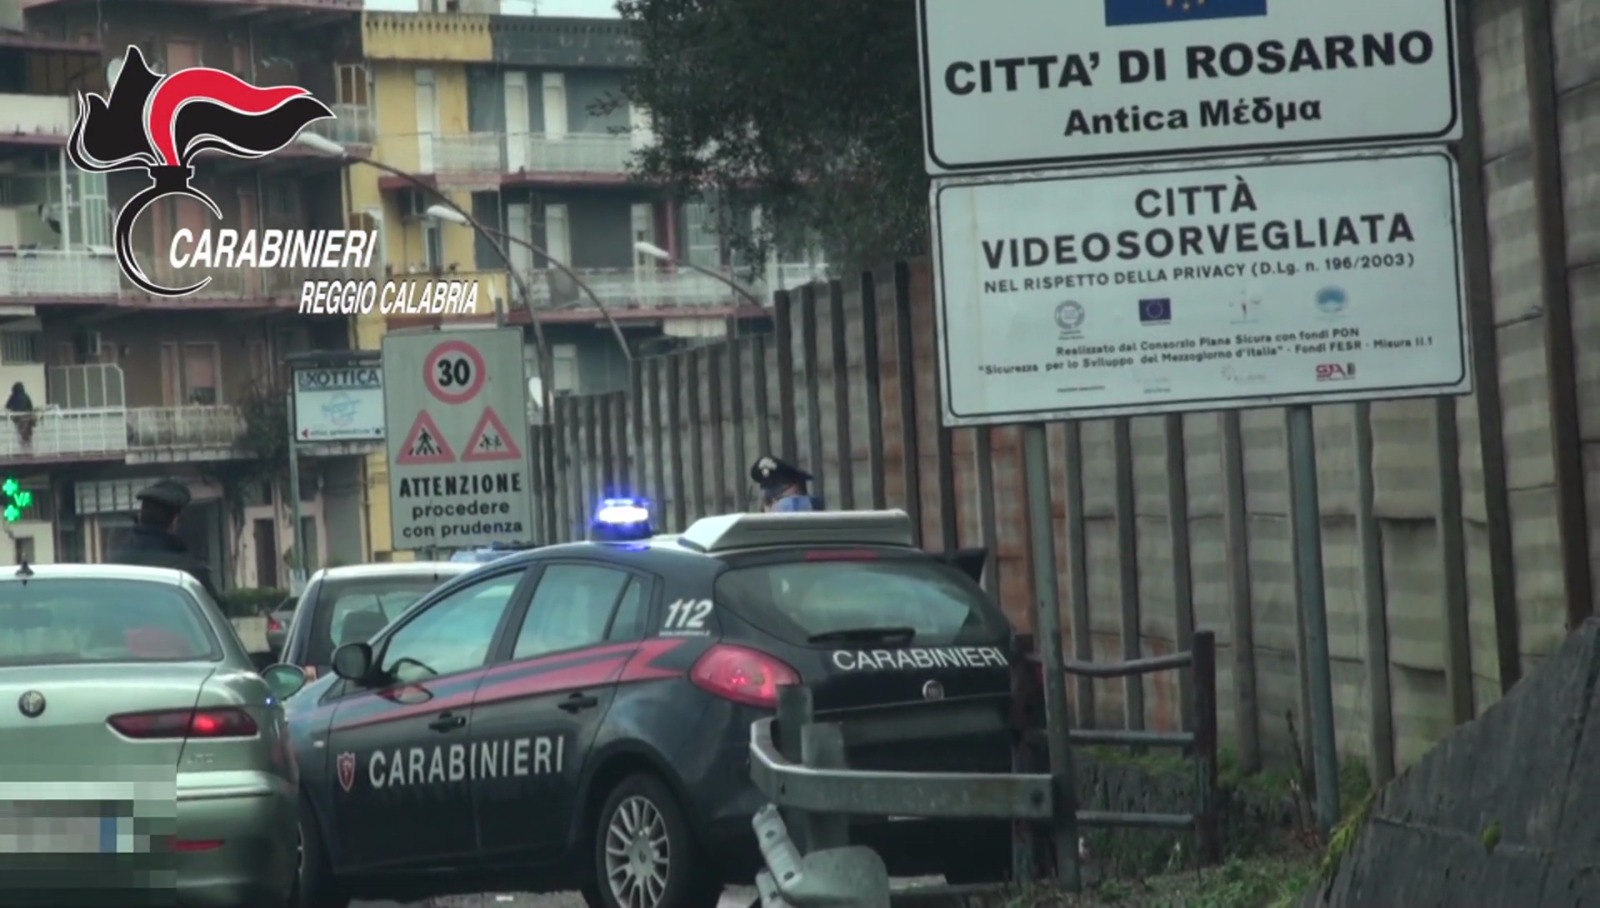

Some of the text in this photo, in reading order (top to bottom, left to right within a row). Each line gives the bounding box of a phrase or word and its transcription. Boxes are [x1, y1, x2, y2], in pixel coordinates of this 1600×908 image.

[1119, 48, 1167, 84] DI
[1187, 31, 1434, 79] ROSARNO
[1064, 99, 1188, 136] Antica
[1135, 176, 1257, 219] CITTÀ
[982, 213, 1415, 270] VIDEOSORVEGLIATA
[984, 279, 1019, 294] NEL
[1025, 272, 1109, 291] RISPETTO
[1115, 268, 1167, 285] DELLA
[1173, 263, 1245, 280] PRIVACY
[1305, 259, 1319, 272] n.
[1325, 252, 1415, 271] 196/2003)
[1045, 359, 1064, 372] per
[1067, 358, 1079, 369] lo
[1082, 355, 1134, 369] Sviluppo
[1140, 353, 1158, 364] del
[1162, 348, 1232, 364] Mezzogiorno
[1295, 343, 1326, 354] Fondi
[1329, 339, 1362, 351] FESR
[1373, 338, 1412, 349] Misura
[1056, 327, 1360, 357] Realizzato dal Consorzio Piana Sicura con fondi PON
[437, 358, 470, 387] 30
[399, 473, 522, 497] ATTENZIONE
[412, 499, 510, 520] procedere
[403, 521, 523, 538] con prudenza
[664, 598, 713, 628] 112
[832, 647, 1008, 671] CARABINIERI
[369, 735, 565, 788] CARABINIERI
